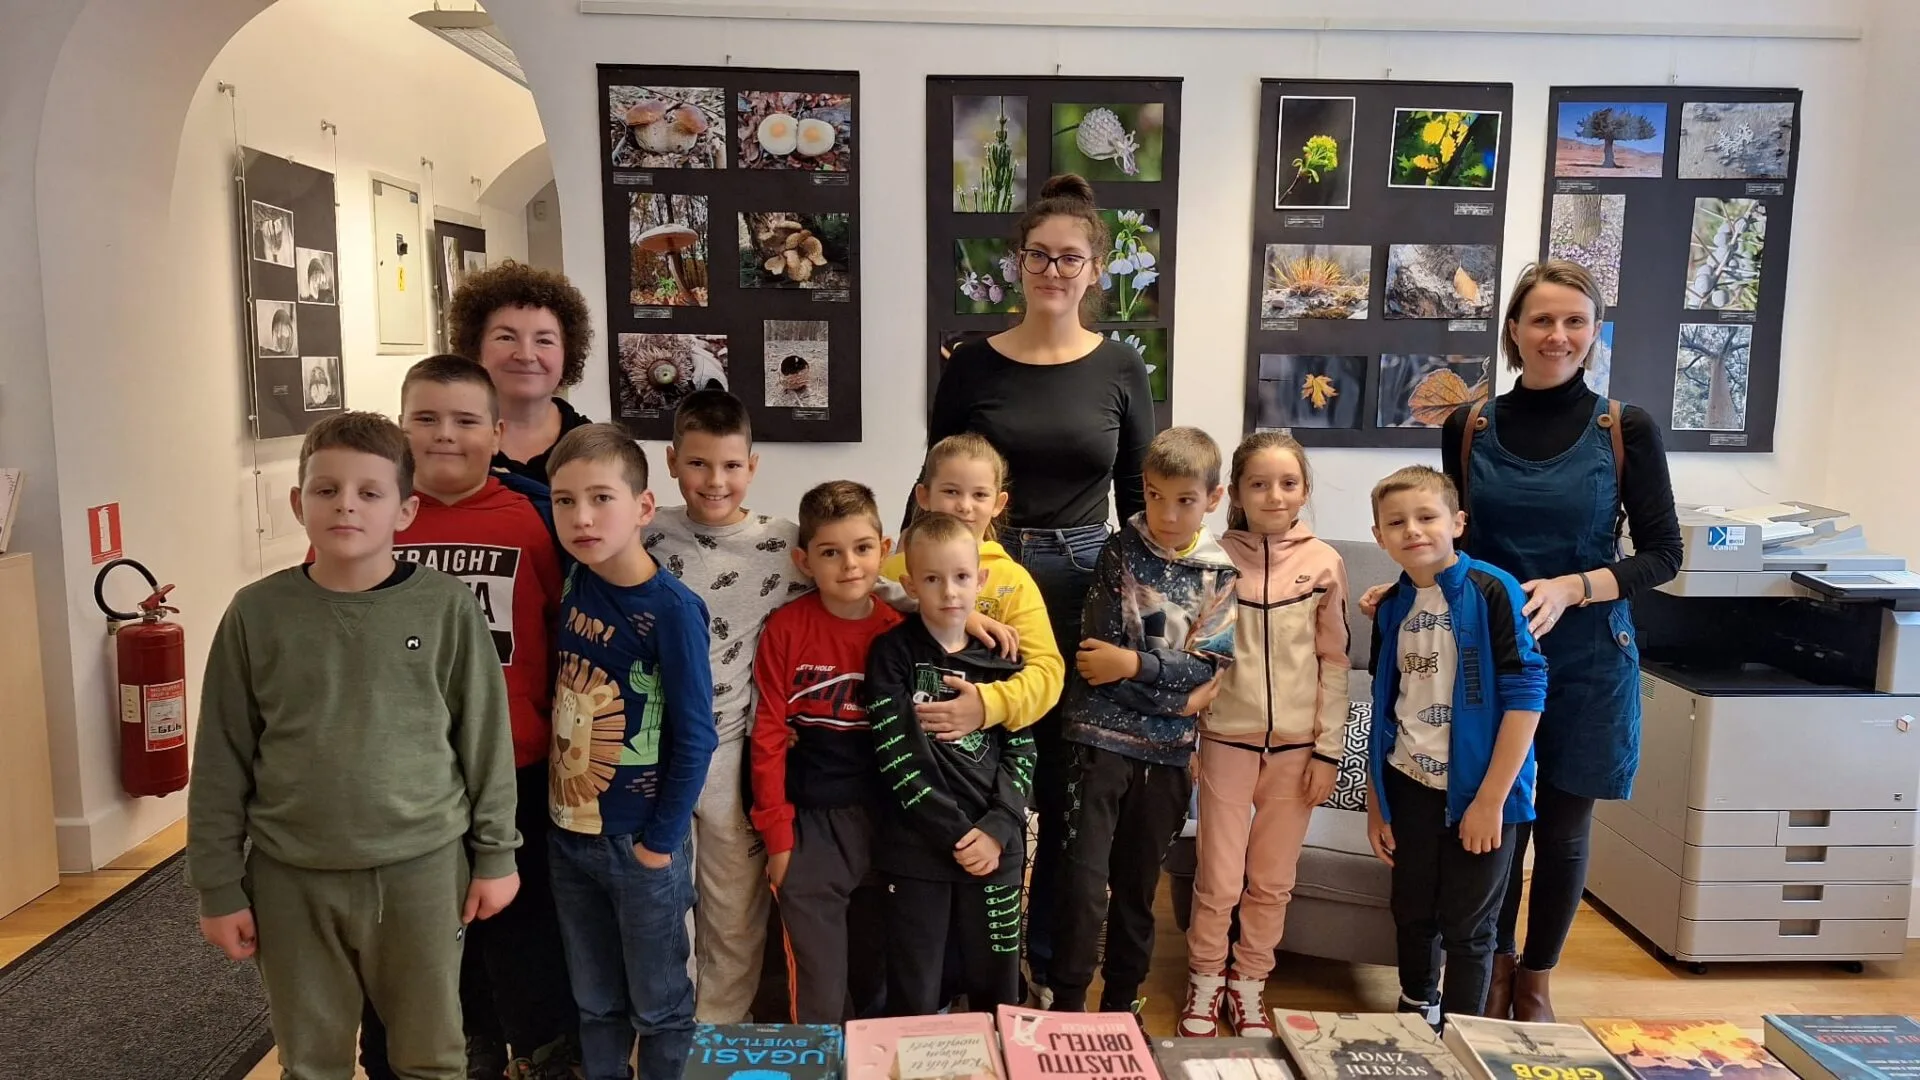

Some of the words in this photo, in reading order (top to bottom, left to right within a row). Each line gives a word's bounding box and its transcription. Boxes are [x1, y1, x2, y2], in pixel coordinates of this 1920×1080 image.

[392, 549, 502, 572] TRAIGHT
[565, 607, 615, 648] ROAR!
[726, 1037, 808, 1048] SVJETLA
[1048, 1033, 1133, 1052] OBITELJ
[701, 1047, 825, 1065] UGASI
[1037, 1053, 1143, 1074] VLASTITU
[1347, 1051, 1408, 1066] život
[1345, 1063, 1429, 1078] stvarni
[1511, 1063, 1604, 1080] GROB
